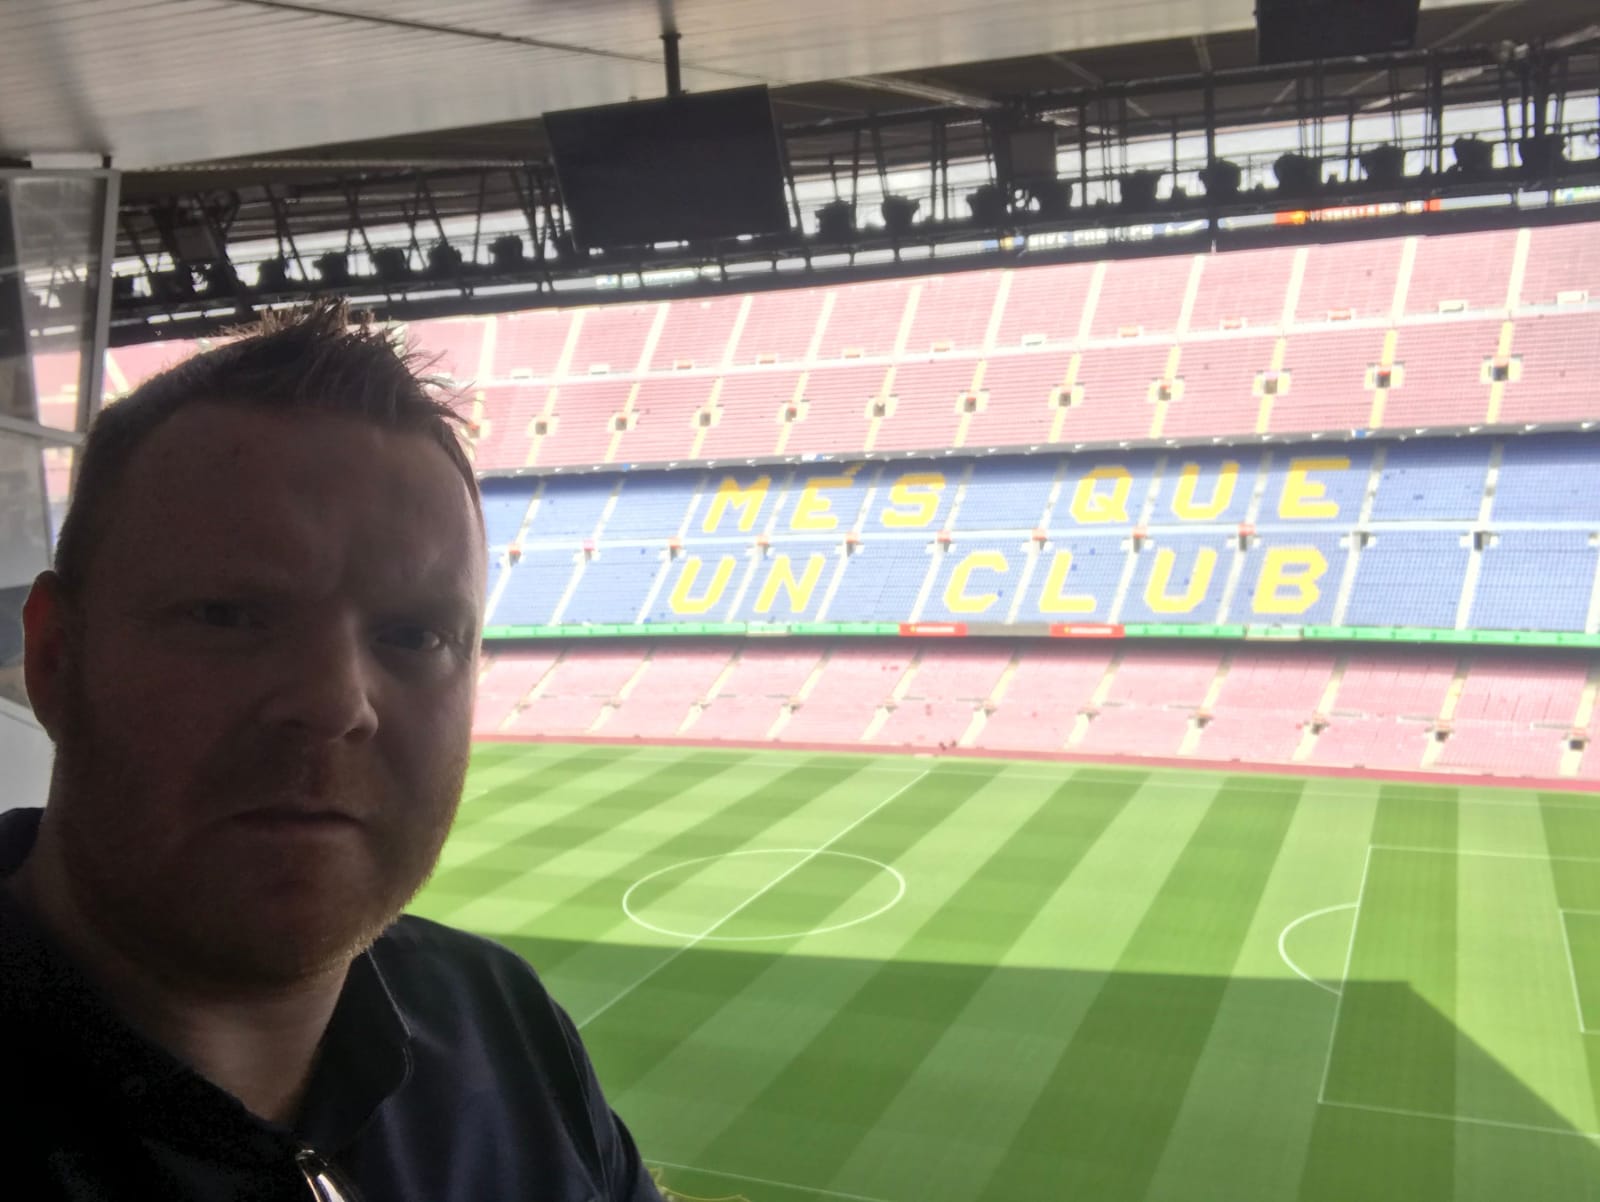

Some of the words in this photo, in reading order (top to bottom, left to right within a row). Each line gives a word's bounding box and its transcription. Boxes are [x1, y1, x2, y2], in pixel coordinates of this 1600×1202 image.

[702, 461, 947, 533] MÉS
[1069, 457, 1352, 523] QUE
[667, 554, 826, 614] UN
[943, 547, 1329, 614] CLUB
